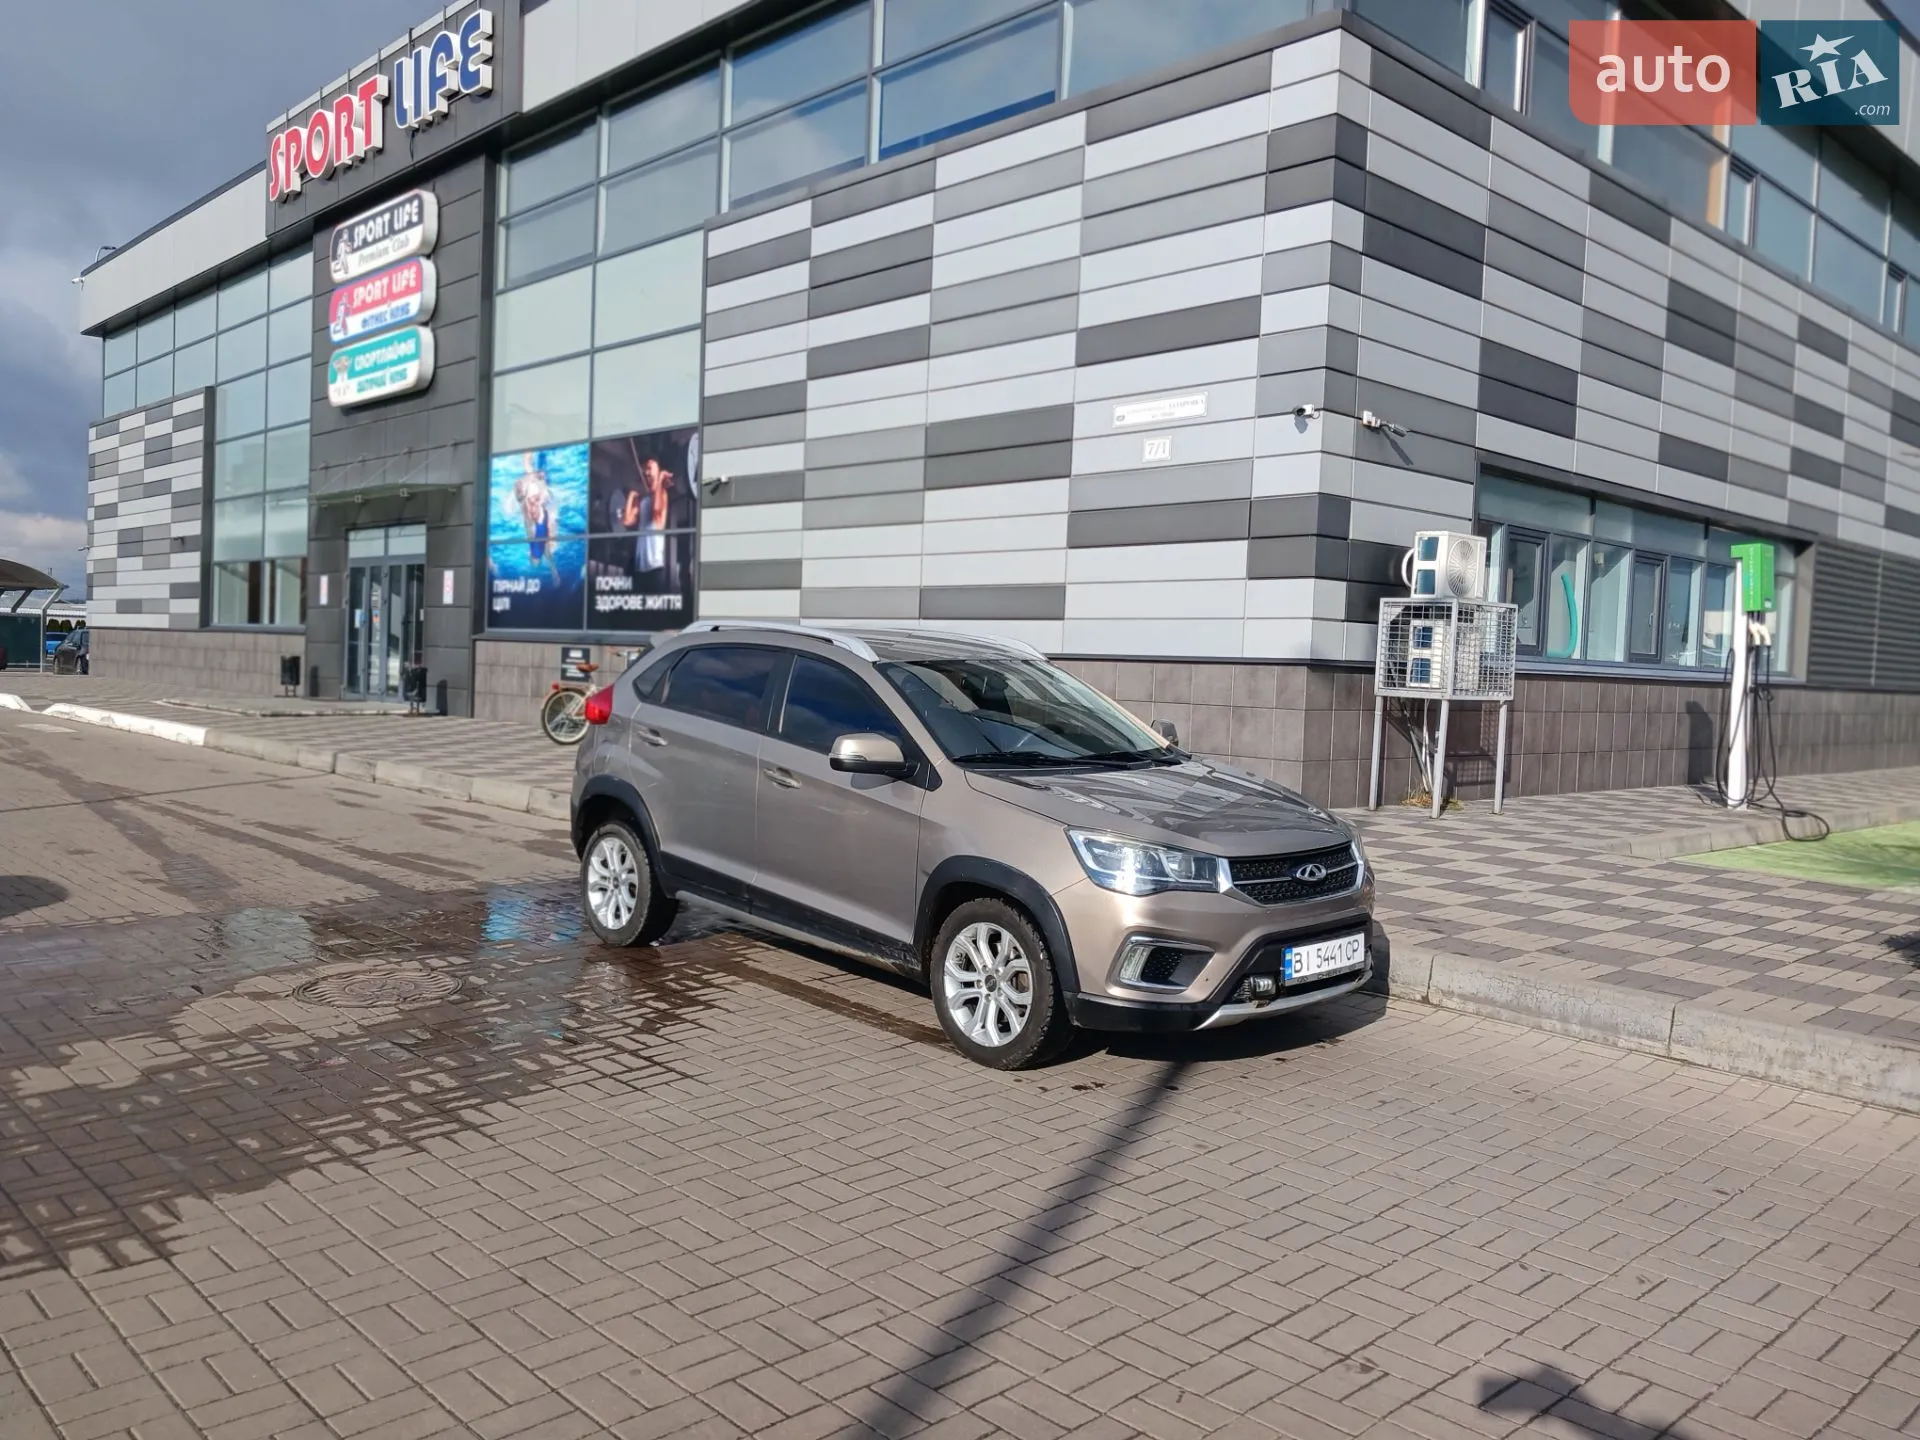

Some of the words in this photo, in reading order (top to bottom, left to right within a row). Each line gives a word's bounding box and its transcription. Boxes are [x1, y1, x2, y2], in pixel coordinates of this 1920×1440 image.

[270, 74, 388, 201] SPORT
[394, 9, 492, 129] LIFE
[353, 214, 390, 248] SPORT
[393, 199, 419, 234] LIFE
[353, 275, 390, 308] SPORT
[392, 265, 417, 294] LIFE
[1147, 441, 1167, 456] 7/1
[595, 576, 633, 591] ПОЧНИ
[594, 595, 644, 613] ЗДОРОВЕ
[644, 594, 682, 611] ЖИТТЯ
[1294, 952, 1310, 973] BI
[1316, 944, 1342, 969] 5441
[1346, 939, 1360, 960] CP
